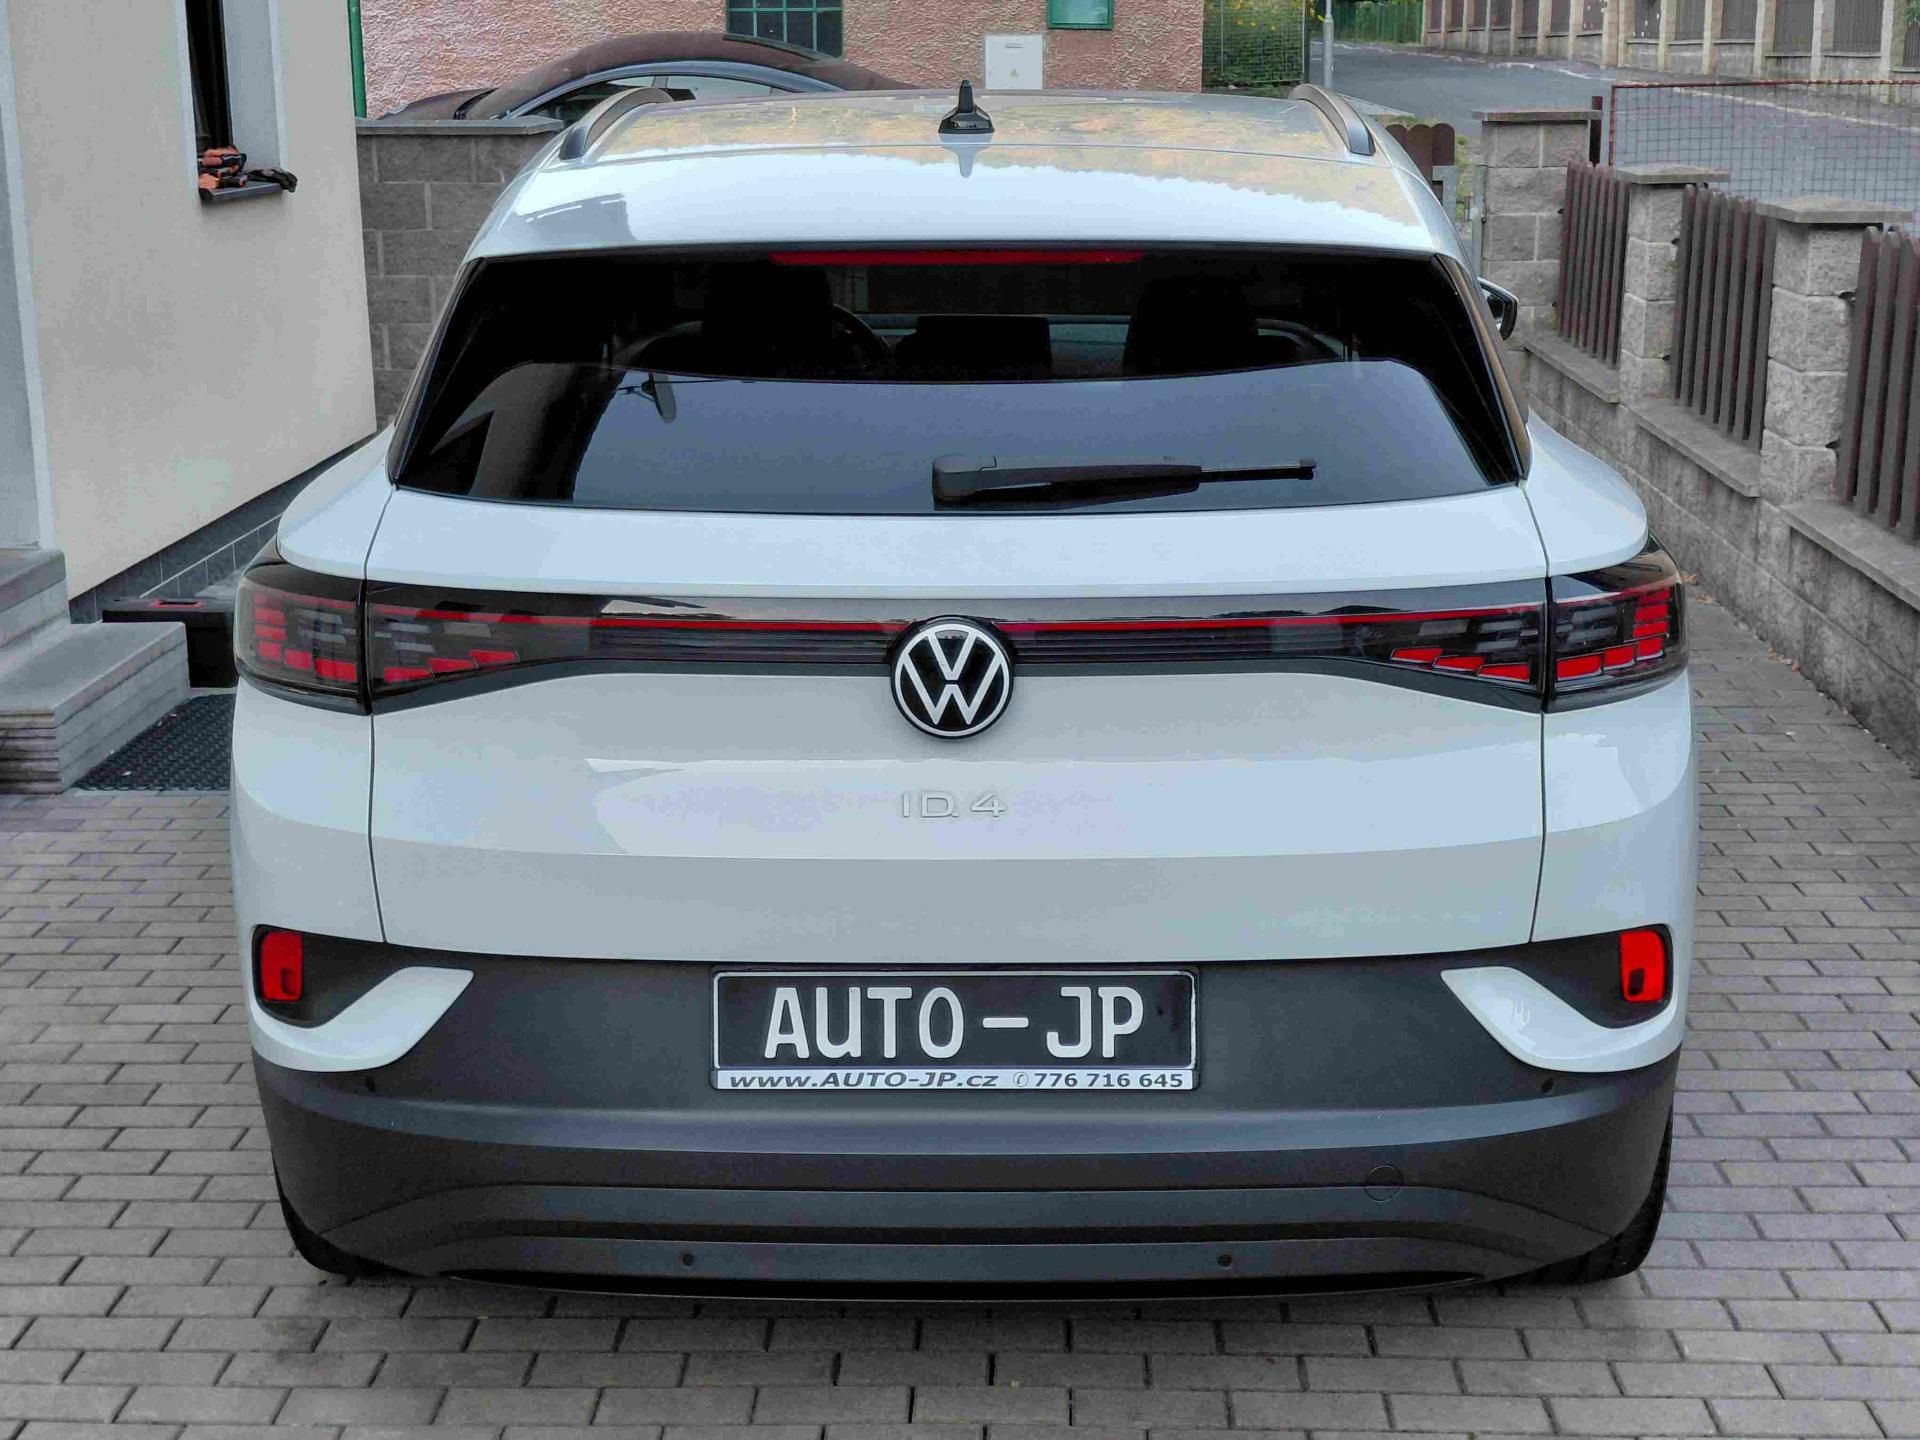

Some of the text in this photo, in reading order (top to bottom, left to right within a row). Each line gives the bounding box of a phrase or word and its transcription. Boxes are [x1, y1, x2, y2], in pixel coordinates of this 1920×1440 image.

[896, 623, 1010, 737] VW
[730, 1072, 1183, 1089] www.AUTO-JP.cz 776 716 645
